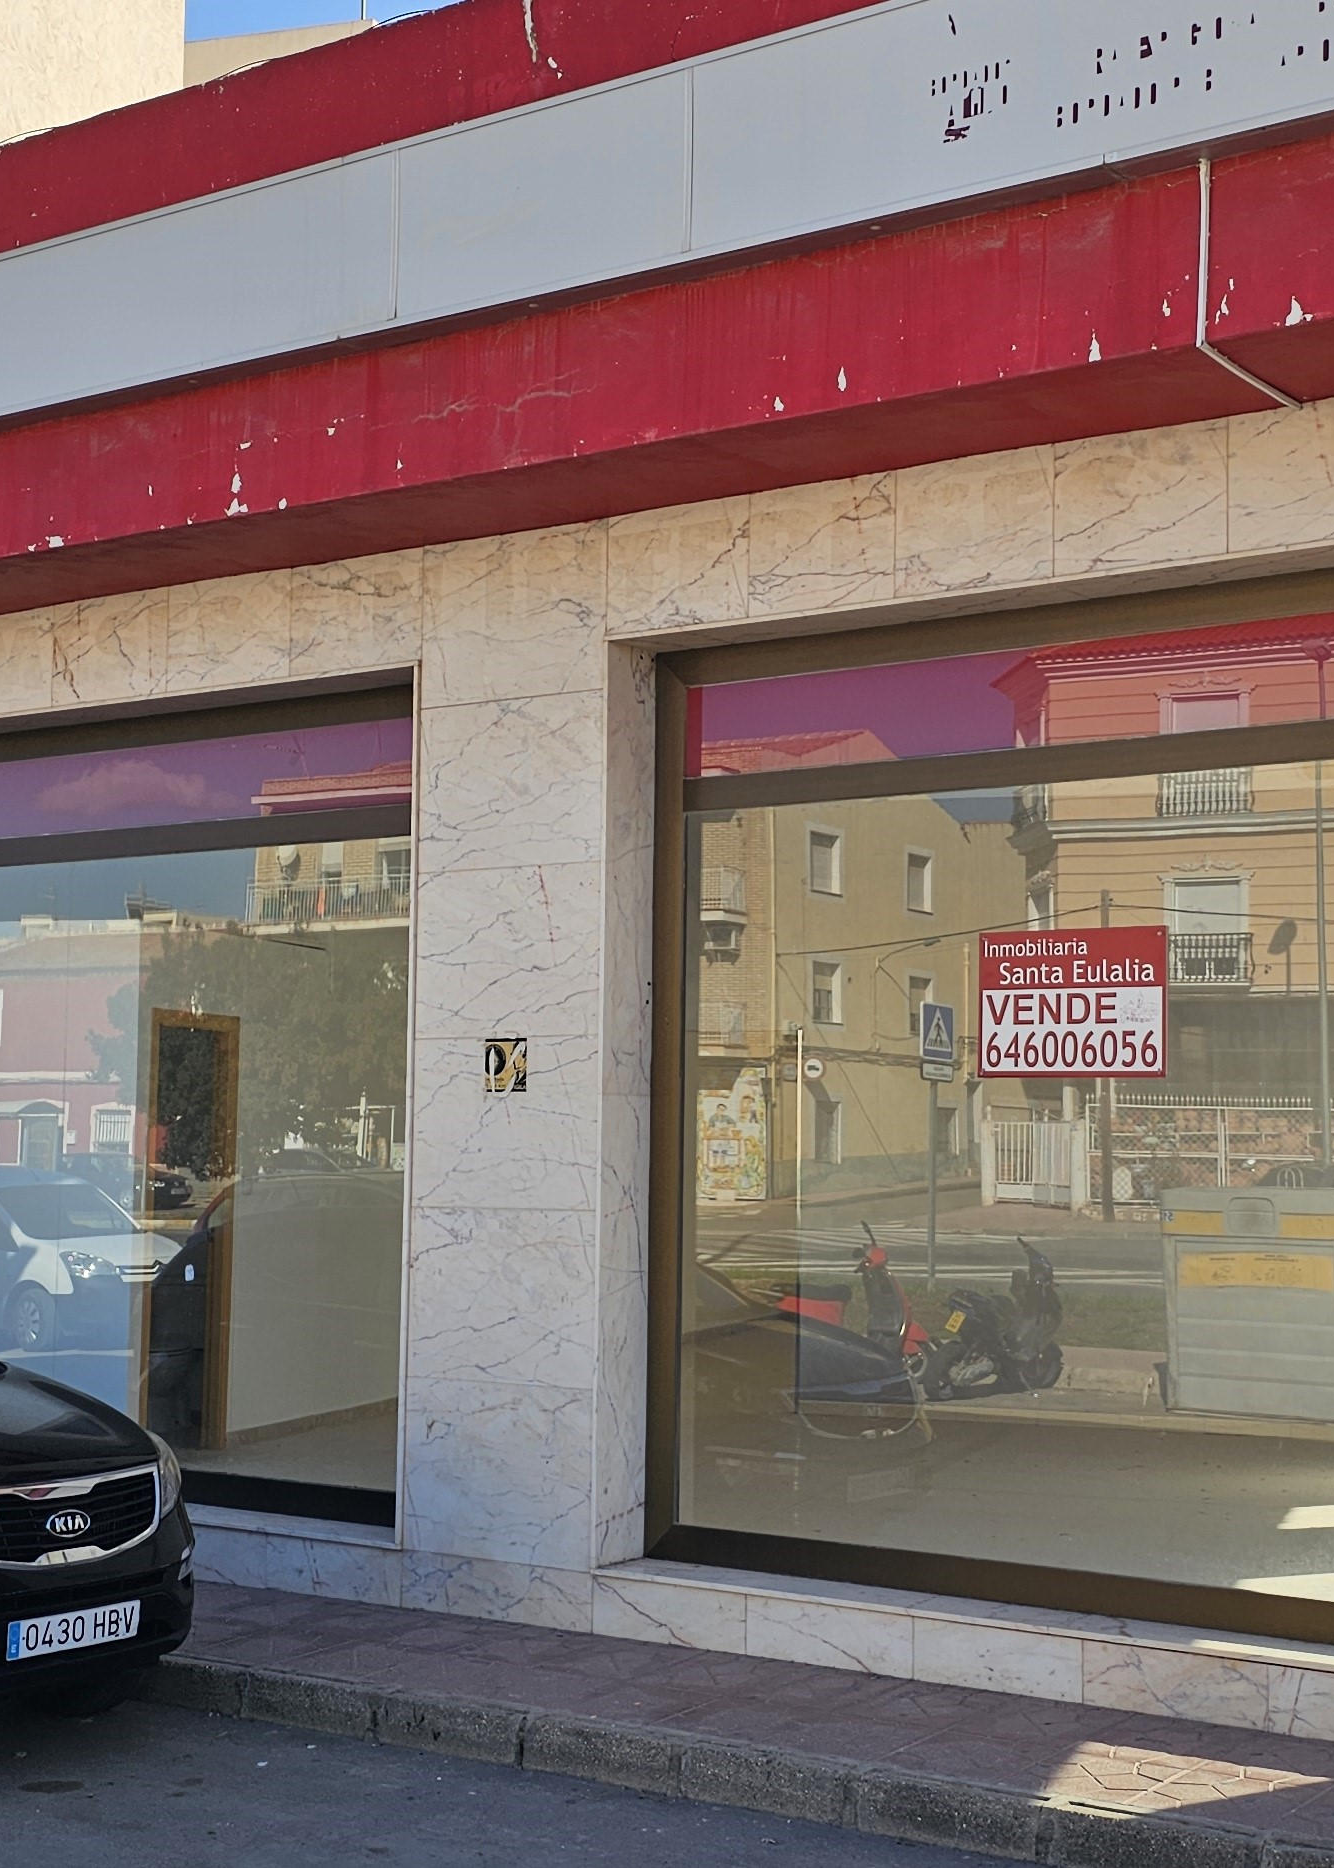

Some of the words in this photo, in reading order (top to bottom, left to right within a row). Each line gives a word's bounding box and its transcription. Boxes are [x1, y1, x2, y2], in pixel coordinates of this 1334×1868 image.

[984, 938, 1087, 957] Inmobiliaria
[999, 962, 1063, 985] Santa
[1073, 958, 1155, 983] Eulalia
[985, 992, 1117, 1026] VENDE
[986, 1030, 1158, 1068] 646006056
[55, 1514, 85, 1533] KIA
[25, 1615, 85, 1651] 0430
[93, 1605, 135, 1639] HBV
